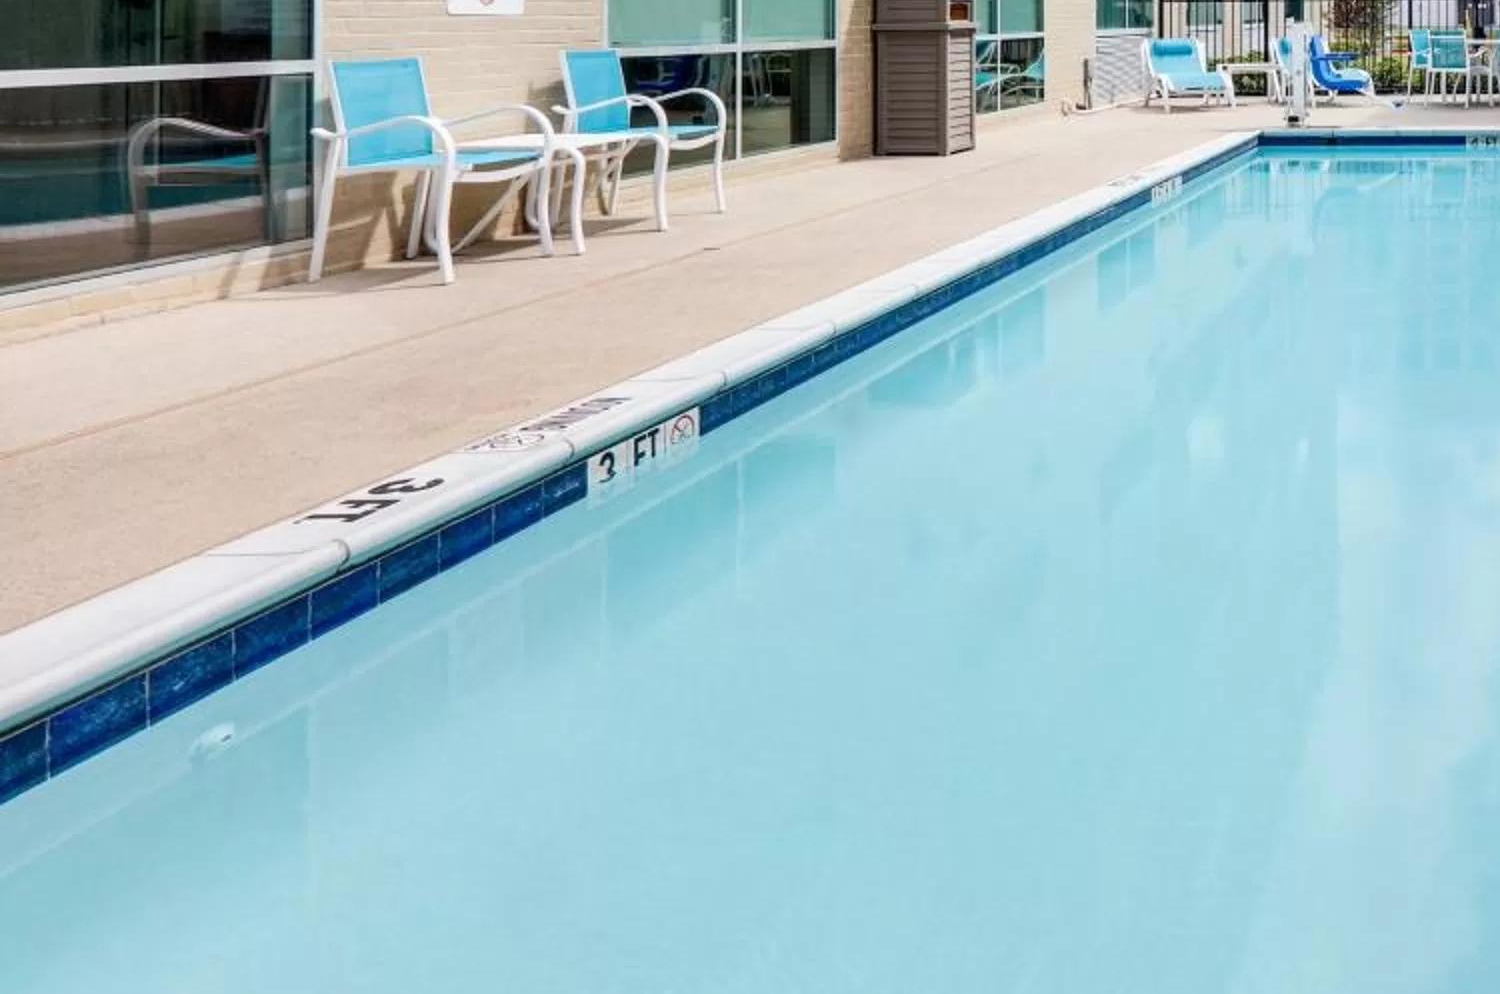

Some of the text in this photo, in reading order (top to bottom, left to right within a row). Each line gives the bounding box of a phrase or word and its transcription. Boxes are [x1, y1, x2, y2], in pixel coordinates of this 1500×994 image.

[599, 428, 661, 484] 3 FT
[367, 477, 445, 495] 3
